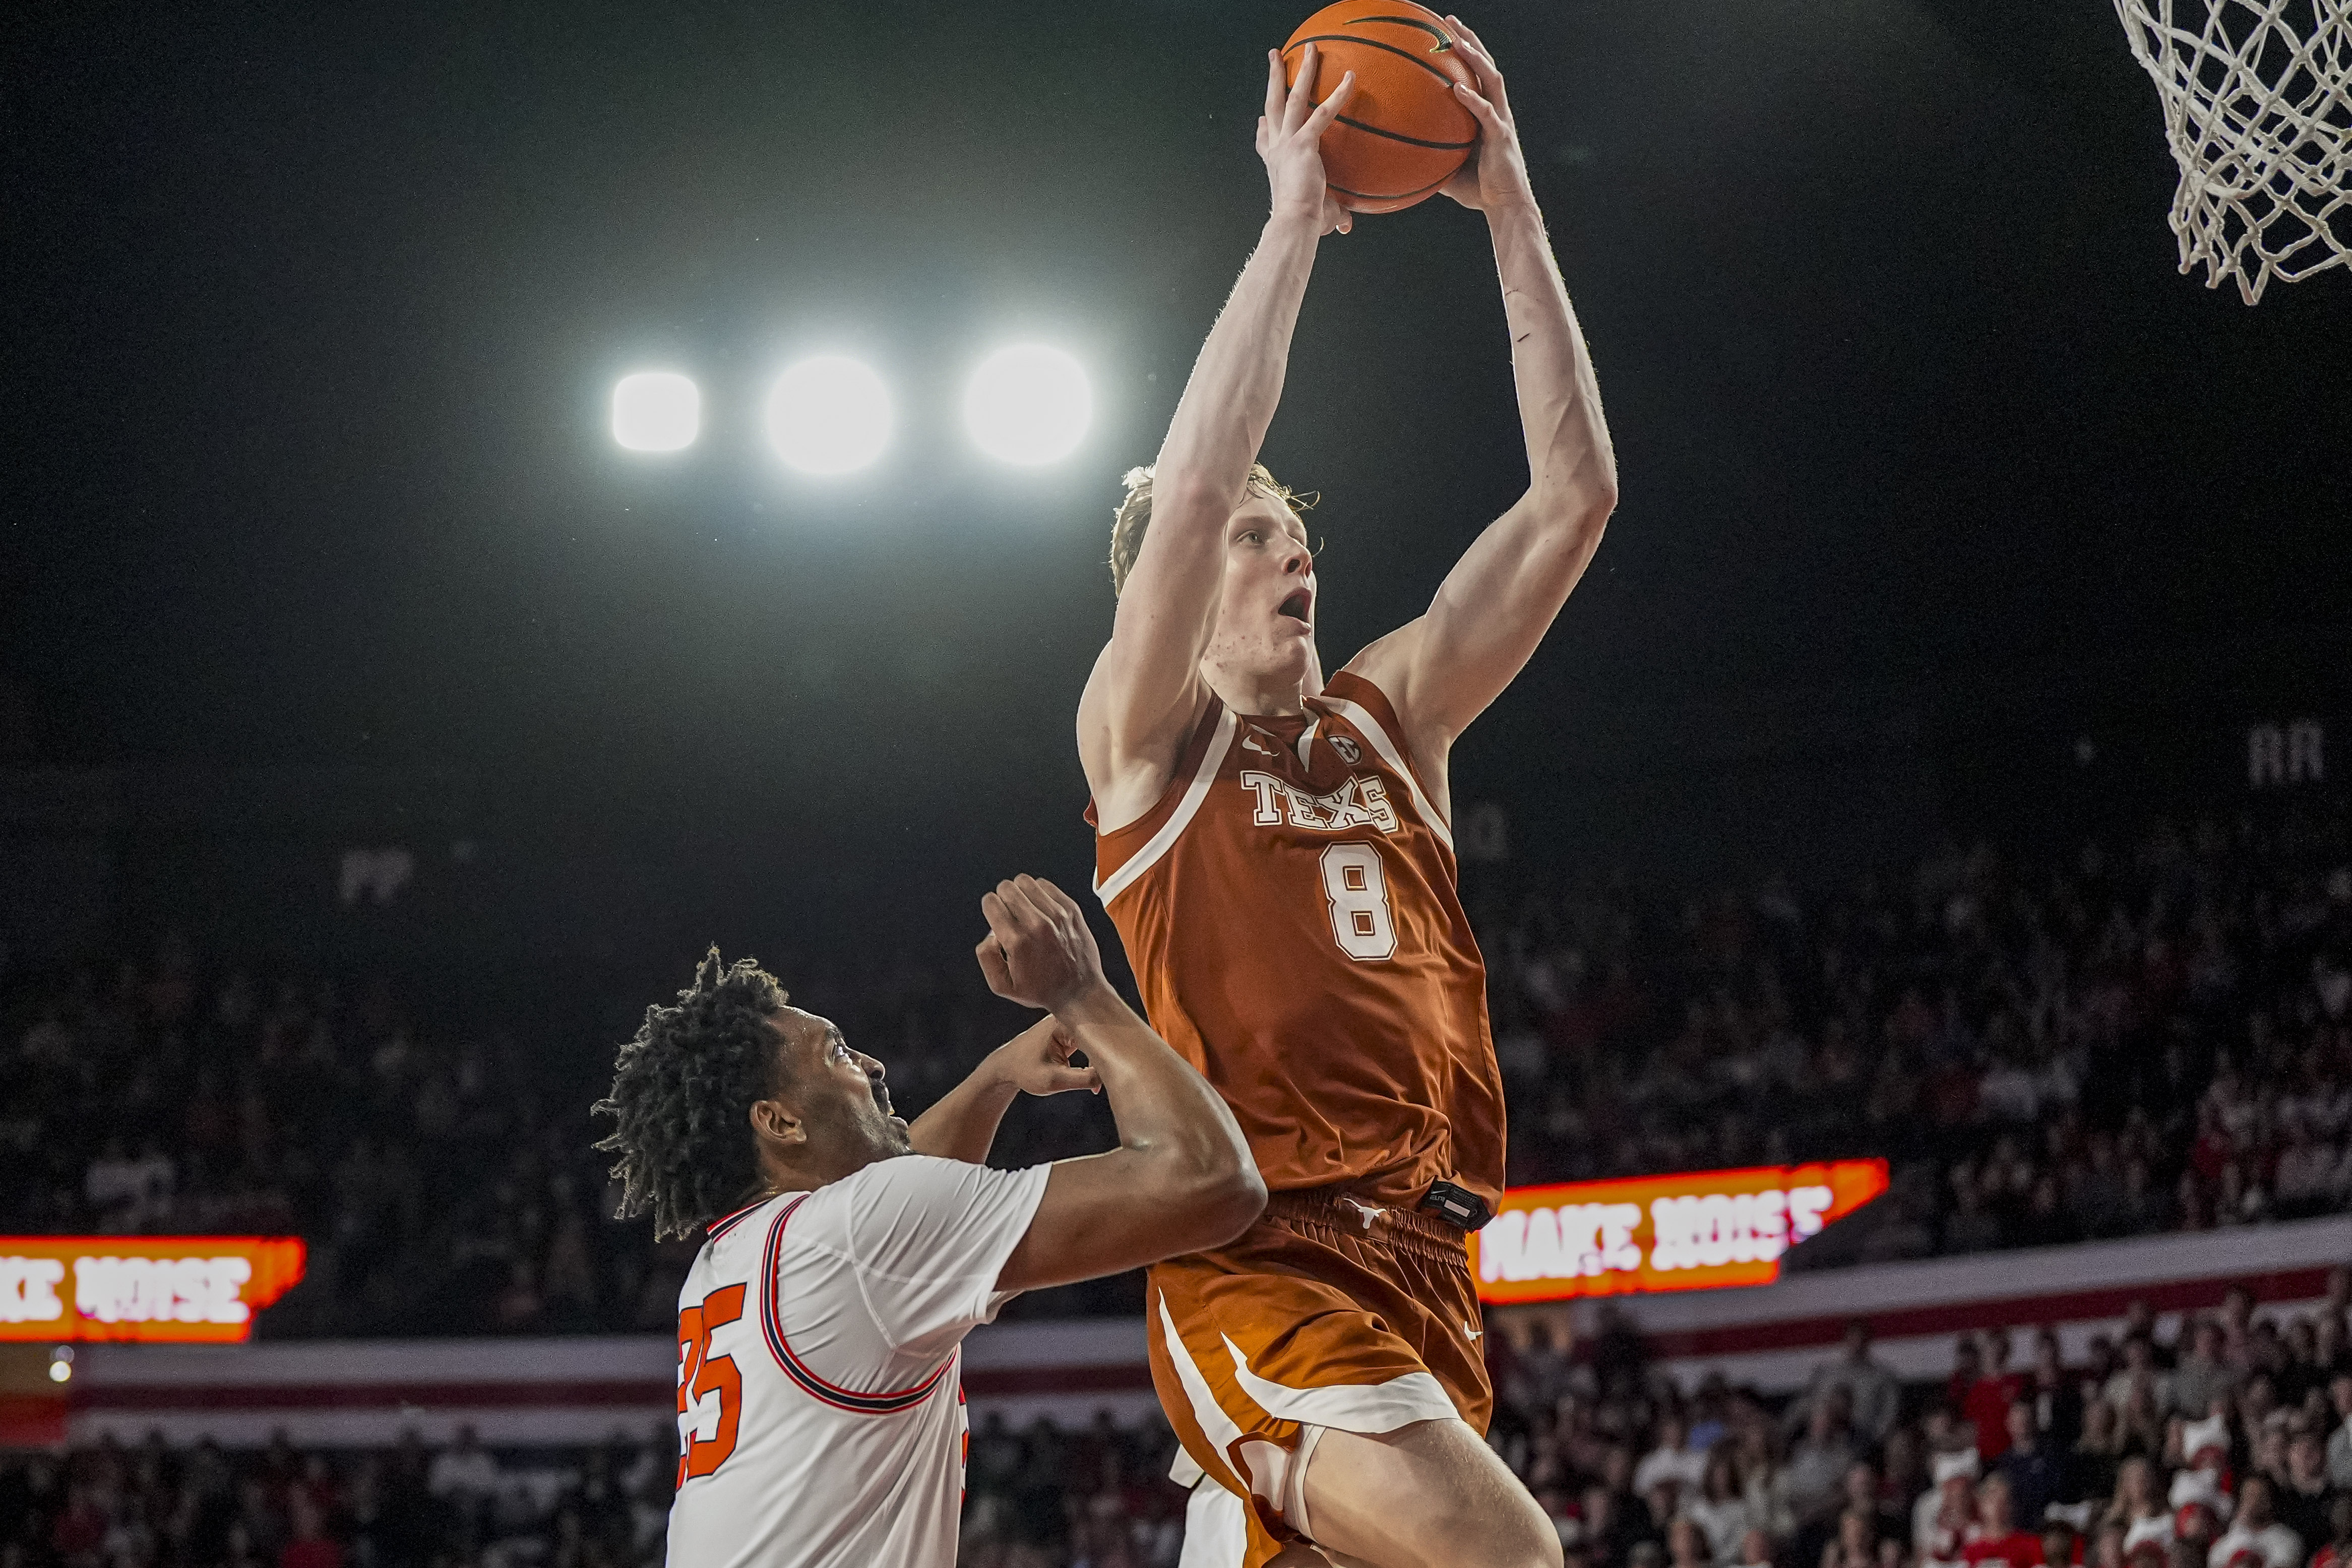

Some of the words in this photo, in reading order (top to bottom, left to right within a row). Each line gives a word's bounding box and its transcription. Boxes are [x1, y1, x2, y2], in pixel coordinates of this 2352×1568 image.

[1328, 736, 1359, 763] EC
[1241, 771, 1398, 833] TEXS
[1319, 840, 1398, 961] 8
[74, 1257, 252, 1323] NOISE
